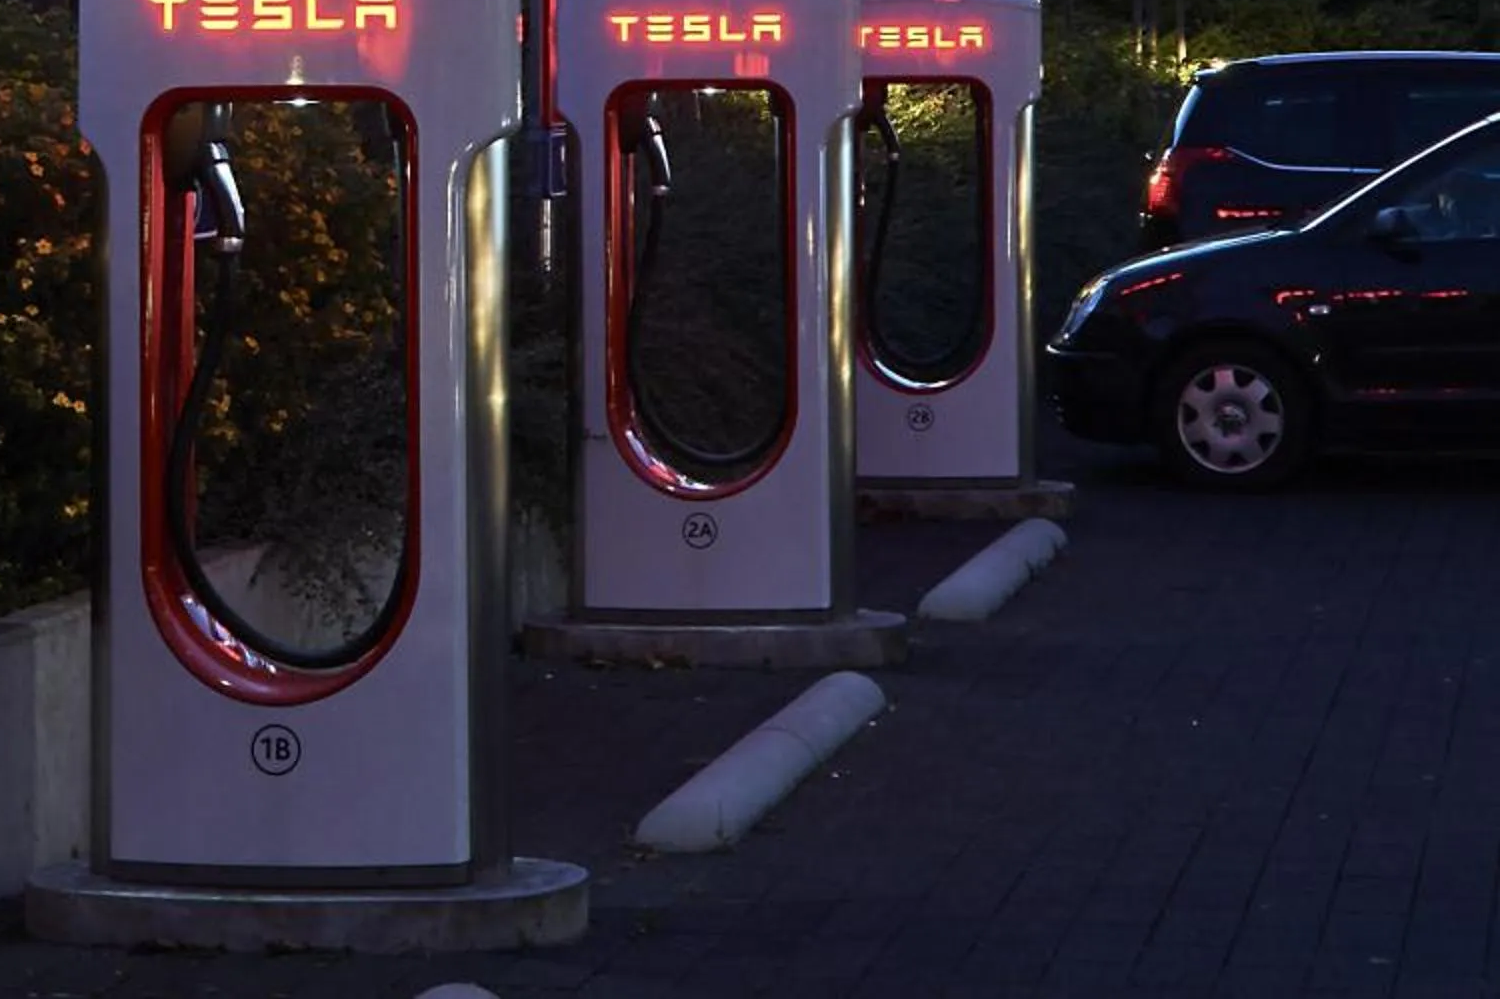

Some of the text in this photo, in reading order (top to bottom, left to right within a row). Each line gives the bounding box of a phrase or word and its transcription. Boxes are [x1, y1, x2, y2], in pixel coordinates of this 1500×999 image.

[610, 14, 782, 42] TESLA
[688, 521, 713, 538] 2A
[260, 737, 290, 760] 1B
